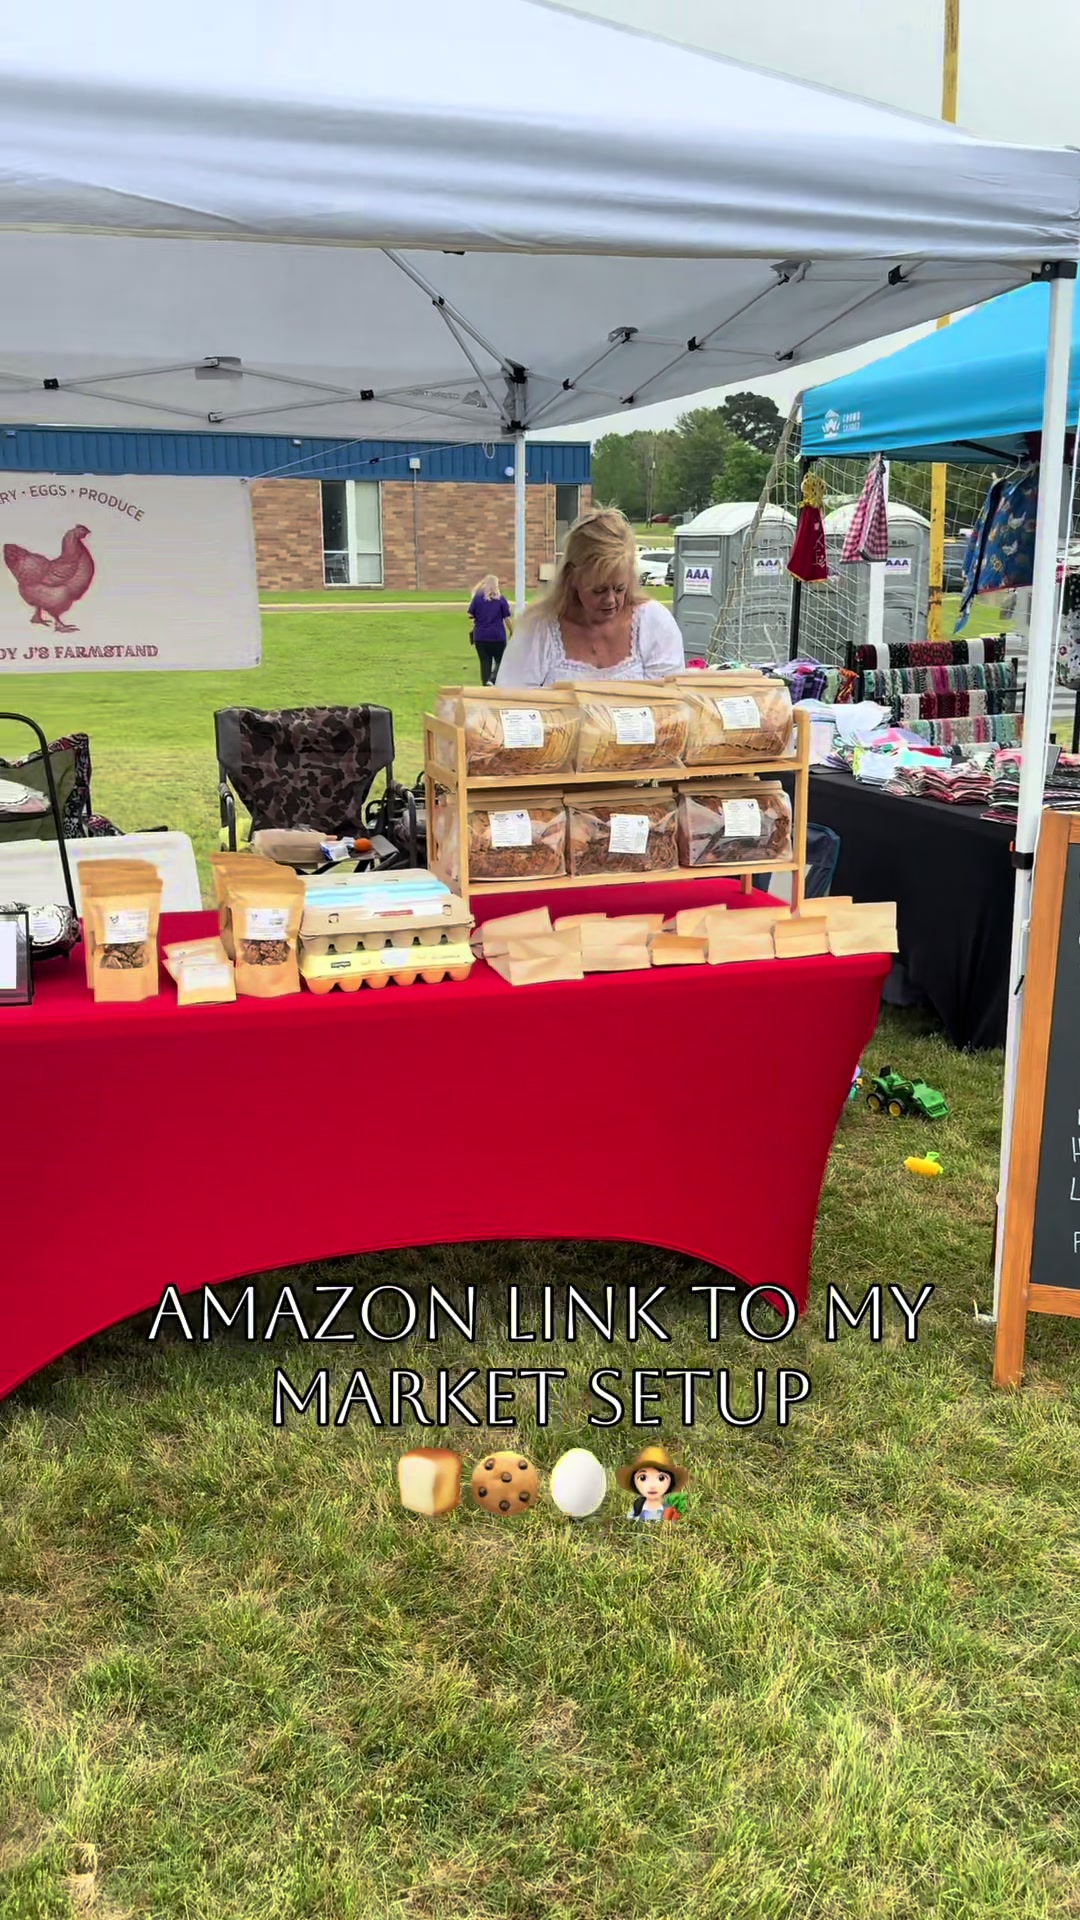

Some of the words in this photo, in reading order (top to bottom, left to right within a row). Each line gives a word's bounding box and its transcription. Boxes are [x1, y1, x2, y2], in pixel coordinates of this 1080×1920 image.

[0, 489, 17, 504] RY
[29, 484, 67, 498] EGGS
[79, 487, 145, 521] PRODUCE
[685, 568, 709, 580] AAA
[23, 646, 50, 660] J'S
[54, 644, 159, 659] FARMSTAND
